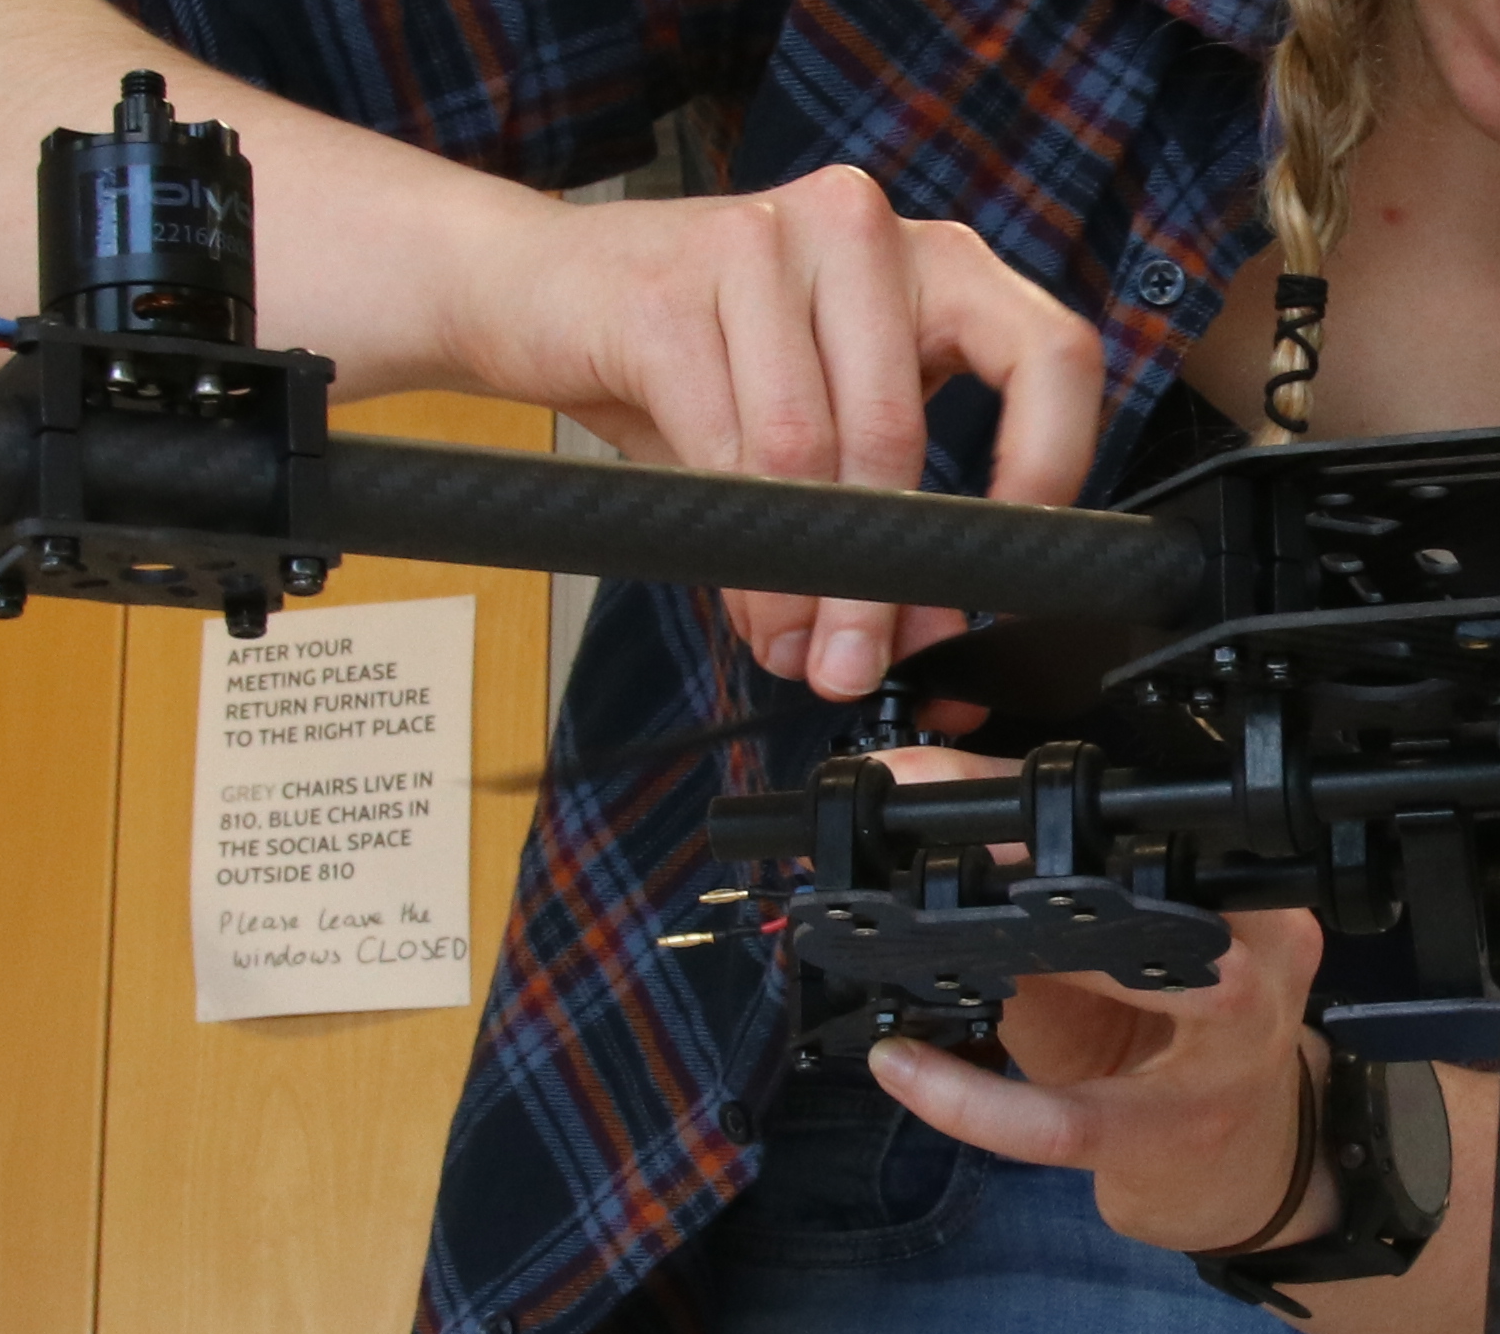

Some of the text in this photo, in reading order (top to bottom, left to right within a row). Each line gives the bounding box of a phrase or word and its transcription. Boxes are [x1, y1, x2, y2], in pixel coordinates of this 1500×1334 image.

[227, 638, 353, 665] AFTER YOUR
[227, 663, 398, 693] MEETING PLEASE
[226, 688, 430, 720] RETURN FURNITURE
[224, 715, 436, 748] TO THE RIGHT PLACE
[221, 771, 433, 803] GREY CHAIRS LIVE IN
[269, 808, 321, 828] BLUE
[327, 802, 401, 824] CHAIRS
[409, 800, 429, 817] IN
[218, 829, 412, 857] THE SOCIAL SPACE
[217, 862, 355, 885] OUTSIDE 810
[219, 902, 432, 934] Please leave the
[233, 936, 468, 968] windows CLOSED
